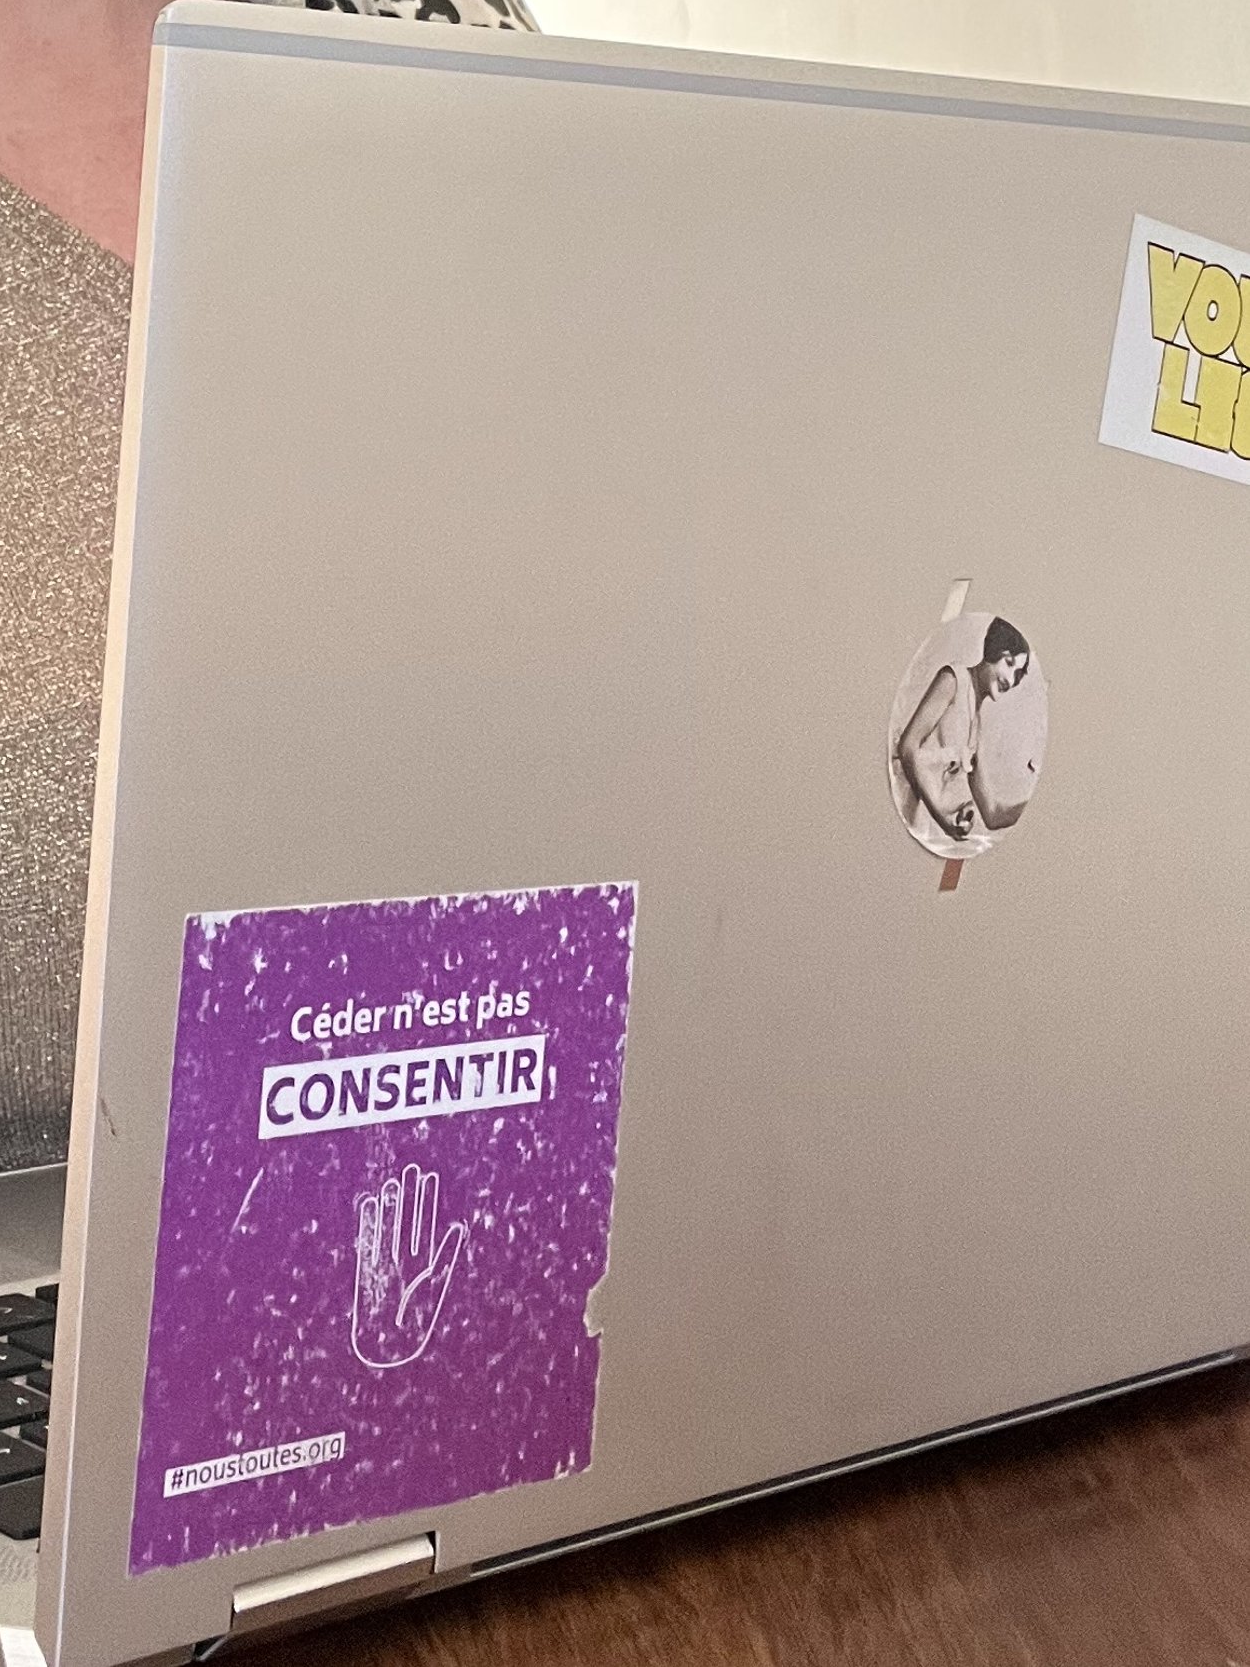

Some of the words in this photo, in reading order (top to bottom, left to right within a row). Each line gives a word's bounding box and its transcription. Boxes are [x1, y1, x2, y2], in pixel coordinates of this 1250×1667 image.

[290, 998, 387, 1042] Céder
[393, 990, 471, 1030] n'est
[476, 989, 531, 1030] pas
[265, 1047, 538, 1126] CONSENTIR
[170, 1436, 342, 1491] #noustoutes.org
